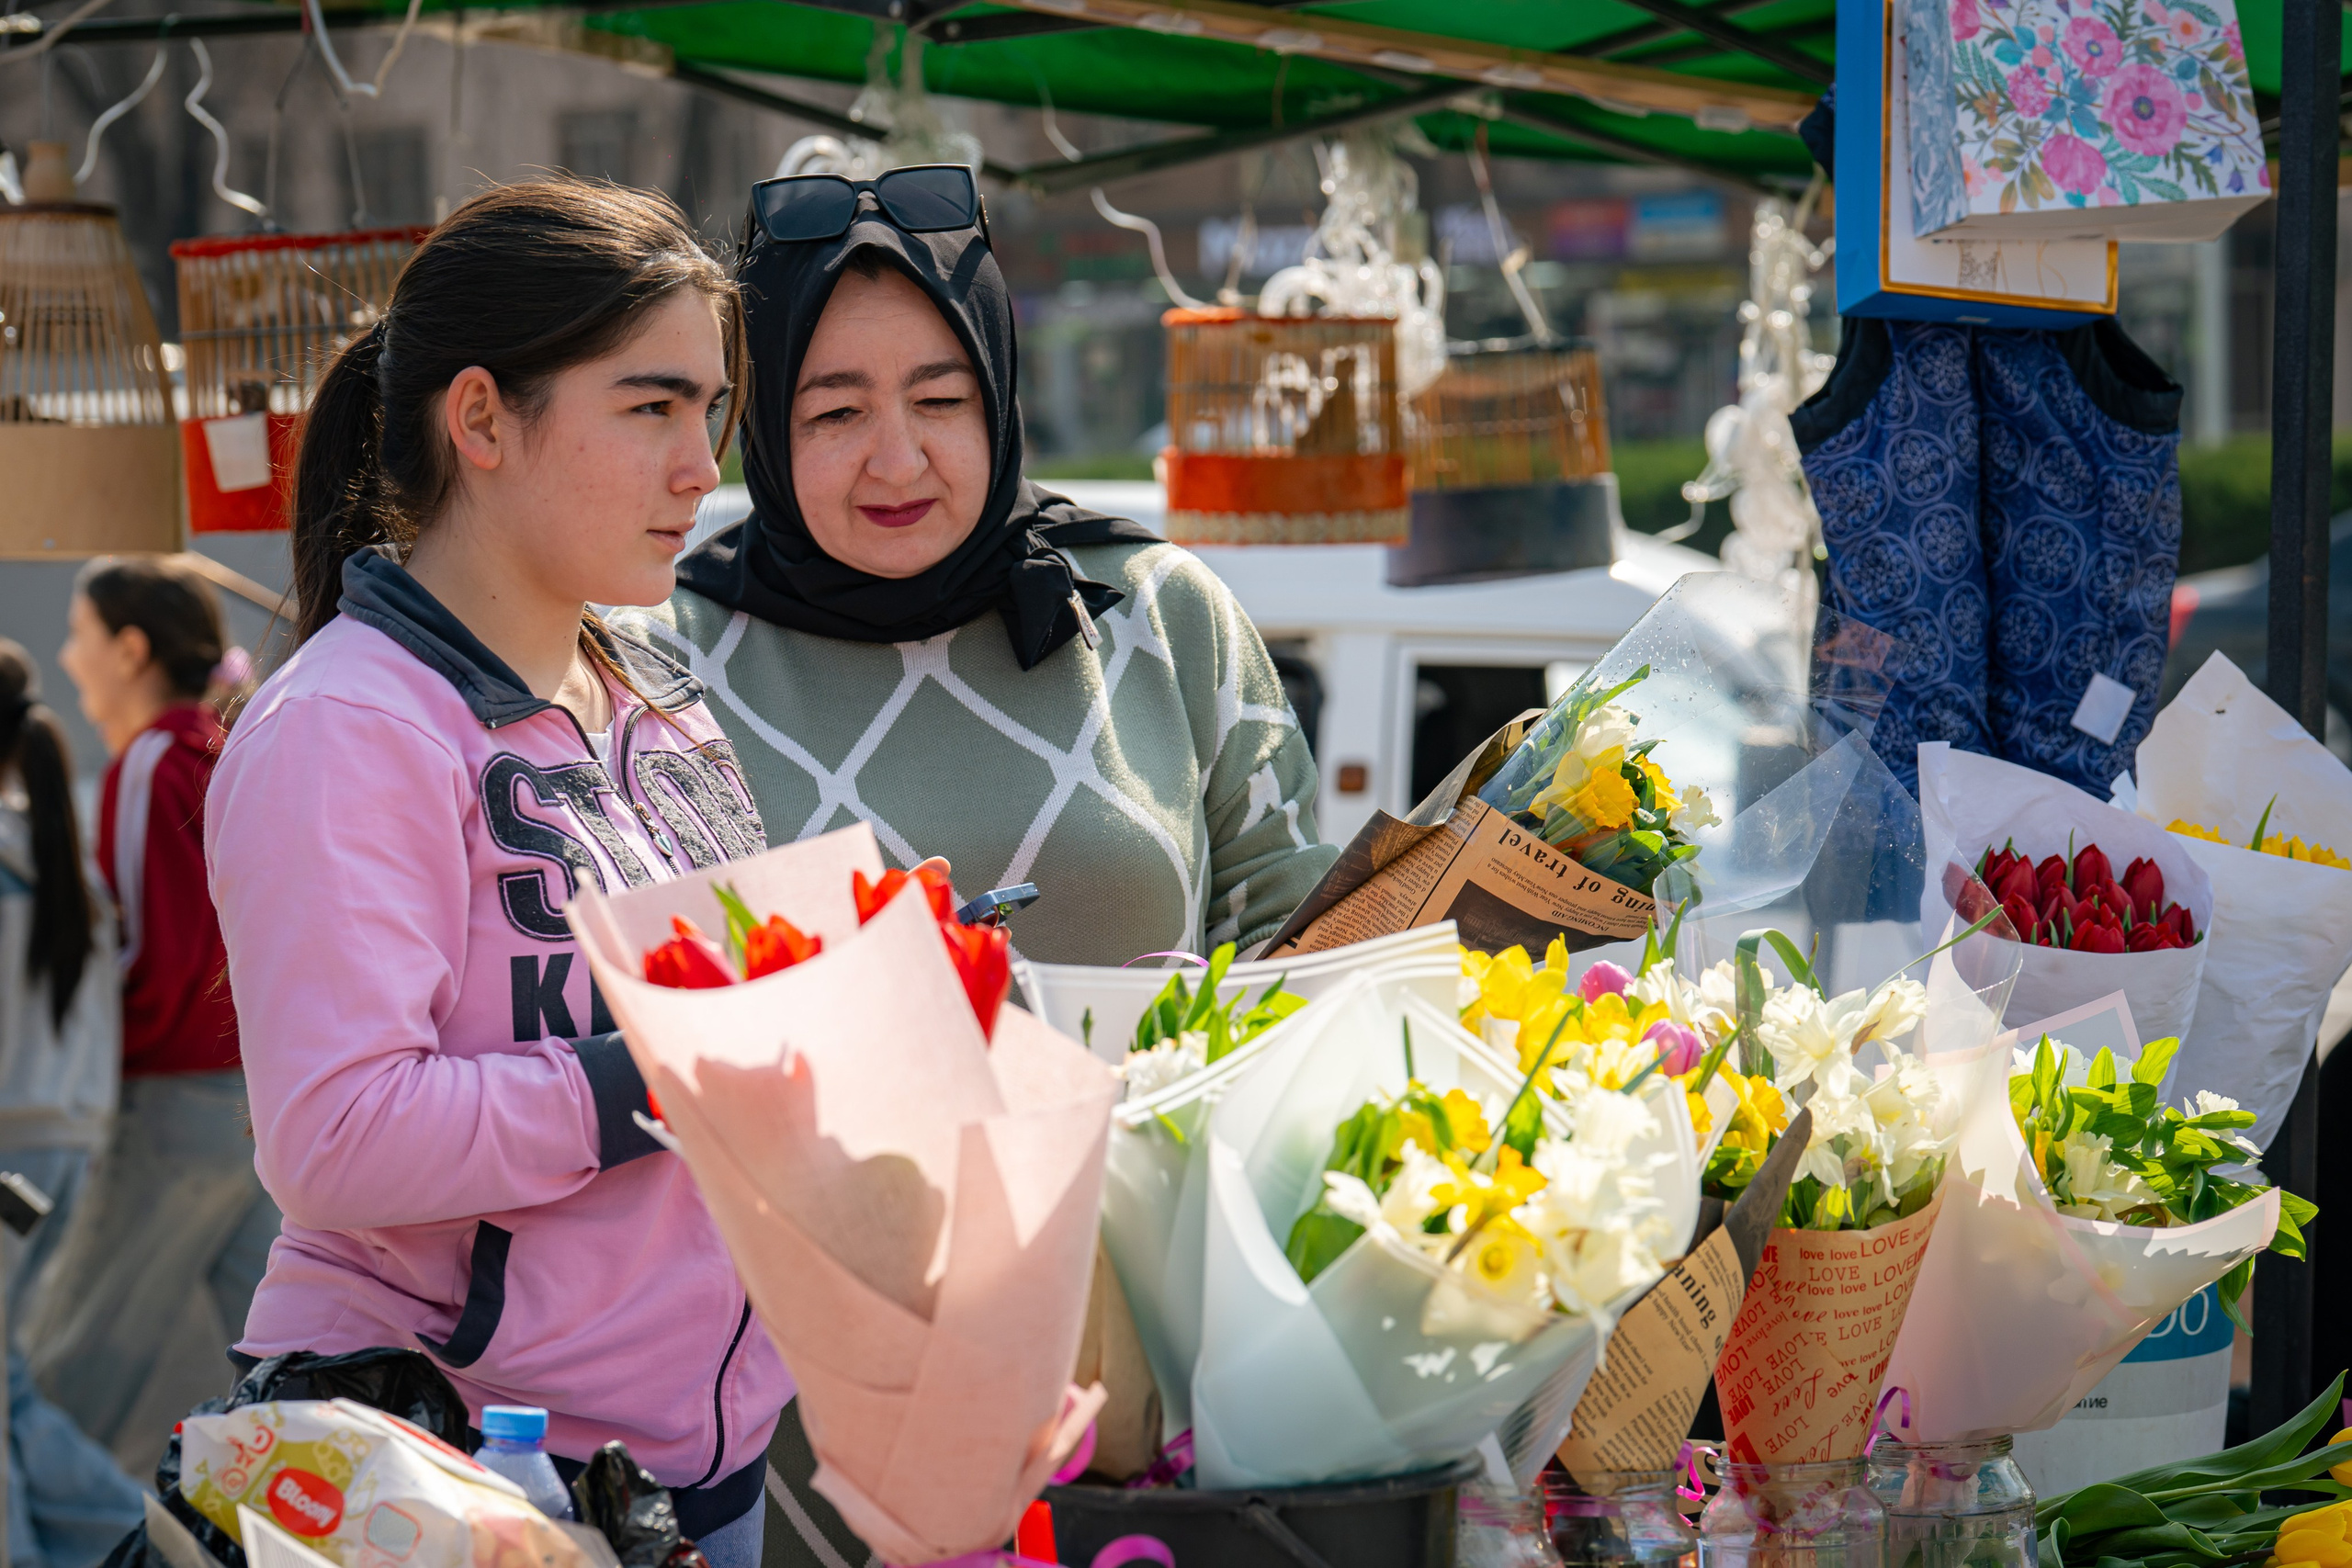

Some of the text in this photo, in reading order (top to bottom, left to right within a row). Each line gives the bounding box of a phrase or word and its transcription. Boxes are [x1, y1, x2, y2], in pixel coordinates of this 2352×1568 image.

[1442, 830, 1459, 845] Please
[1443, 841, 1455, 852] best
[1499, 829, 1567, 878] travel
[1425, 854, 1434, 863] ous
[1433, 860, 1443, 868] per
[1415, 864, 1430, 878] happy
[1422, 861, 1434, 873] have
[1491, 866, 1499, 874] for
[1499, 871, 1516, 884] wishes
[1401, 882, 1416, 895] Good
[1573, 876, 1601, 894] of
[1352, 903, 1371, 915] always
[1552, 902, 1565, 910] New
[1558, 897, 1578, 908] prosper
[1342, 913, 1353, 922] joy
[1565, 907, 1580, 916] happy
[1333, 918, 1355, 930] season's
[1351, 918, 1363, 926] you
[1552, 910, 1609, 931] INCOMING AID
[1317, 932, 1331, 942] year
[1329, 931, 1354, 943] greetings
[1334, 926, 1349, 935] New
[1315, 939, 1329, 948] these
[1800, 1247, 1825, 1260] love
[1830, 1249, 1857, 1260] love
[1860, 1228, 1910, 1258] LOVE
[1807, 1284, 1835, 1295] love
[1840, 1282, 1867, 1295] love
[1873, 1258, 1915, 1287] LOVE
[1809, 1266, 1860, 1282] LOVE
[1834, 1309, 1859, 1320] love
[1862, 1303, 1883, 1316] love
[1732, 1301, 1767, 1337] LOVE
[1766, 1311, 1789, 1332] love
[1838, 1316, 1882, 1341] LOVE
[1766, 1332, 1809, 1370] LOVE
[1860, 1350, 1877, 1364] love
[1715, 1345, 1749, 1387] LOVE
[1763, 1358, 1805, 1395] LOVE
[1727, 1367, 1764, 1404] LOVE
[1772, 1368, 1825, 1417] Love
[1727, 1393, 1756, 1427] LOVE
[1765, 1416, 1809, 1454] LOVE
